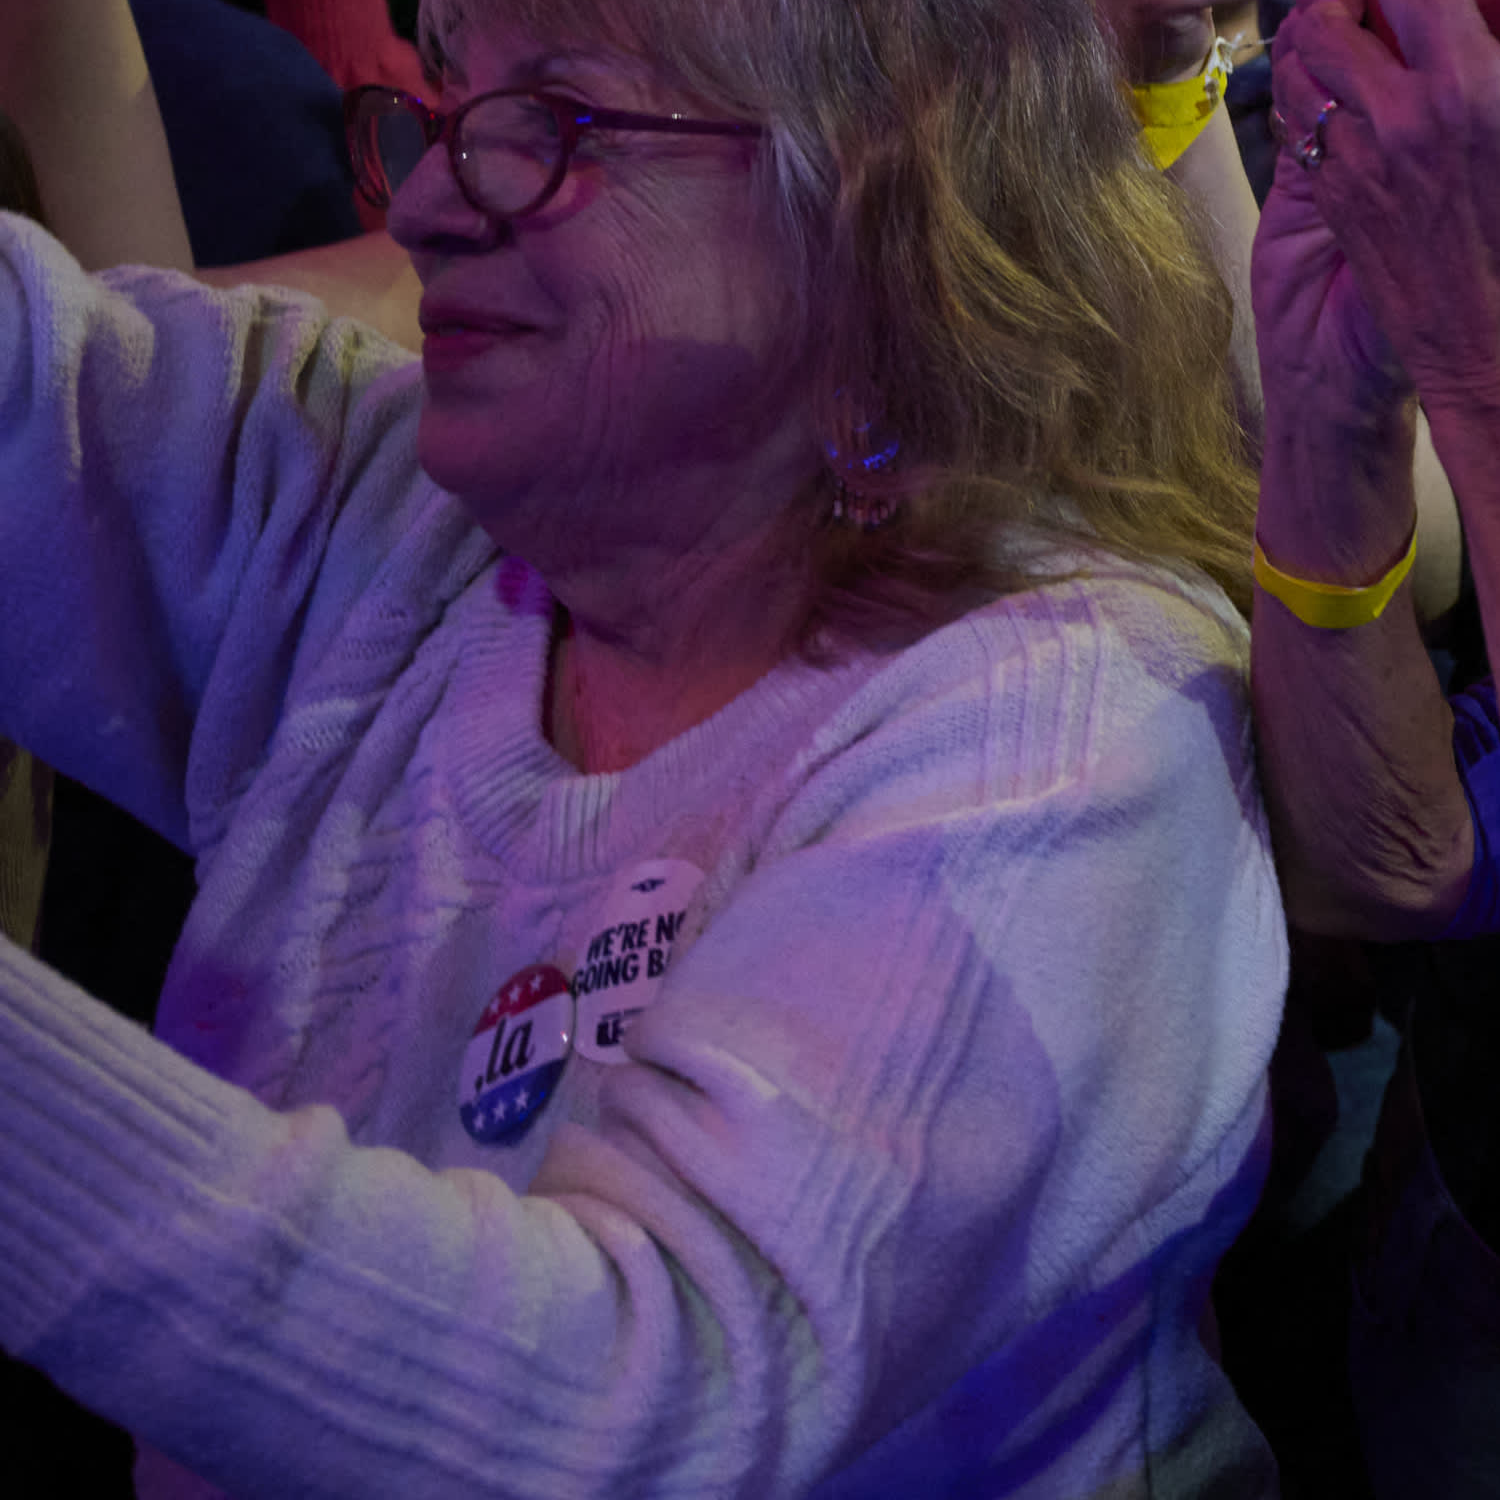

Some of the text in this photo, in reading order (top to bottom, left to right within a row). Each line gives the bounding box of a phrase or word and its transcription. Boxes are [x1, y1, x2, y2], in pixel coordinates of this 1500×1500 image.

[587, 917, 651, 963] WE'RE
[571, 948, 673, 996] GOING B
